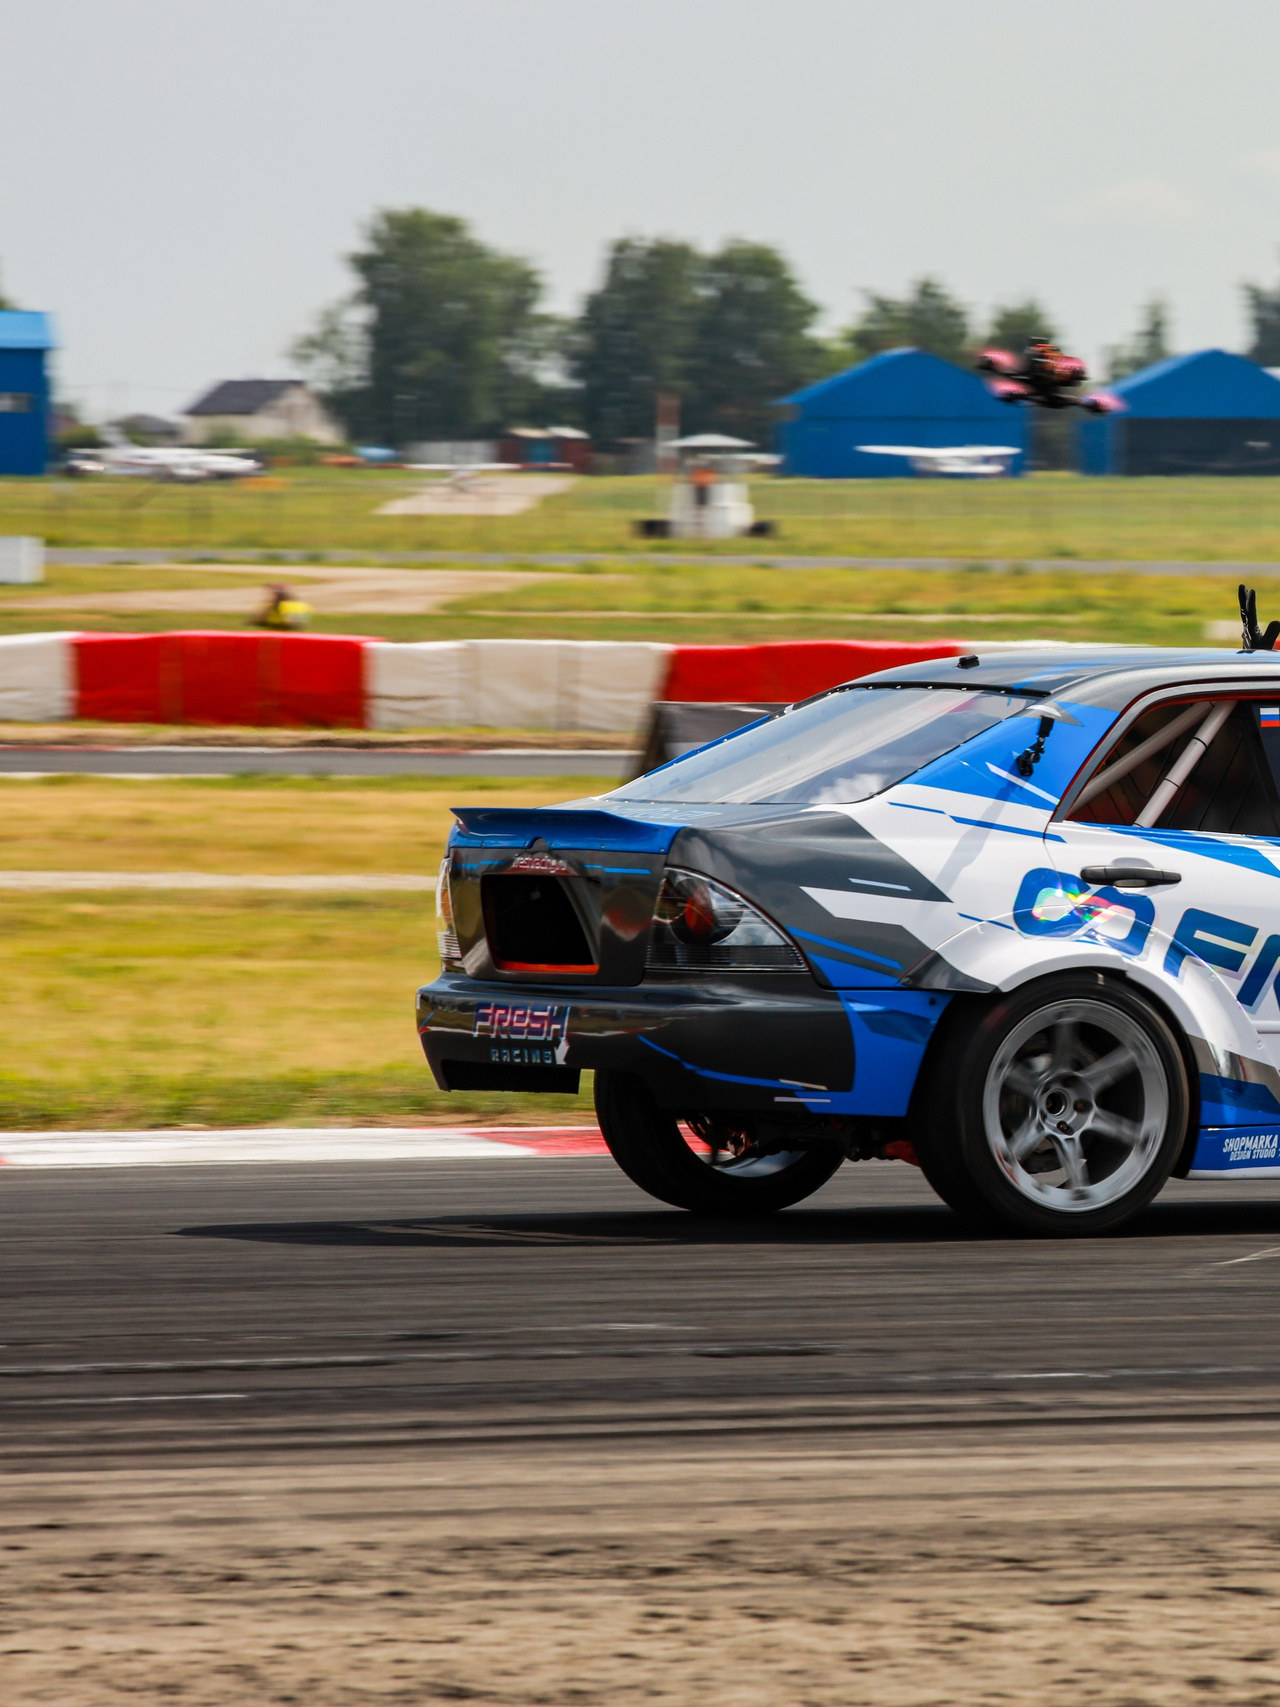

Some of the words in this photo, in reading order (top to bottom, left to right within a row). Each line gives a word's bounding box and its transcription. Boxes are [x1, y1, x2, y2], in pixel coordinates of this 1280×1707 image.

[490, 1047, 552, 1064] RACING
[1222, 1133, 1279, 1153] SHOPMARKA
[1229, 1150, 1251, 1161] DESIGN
[1252, 1148, 1276, 1159] STUDIO
